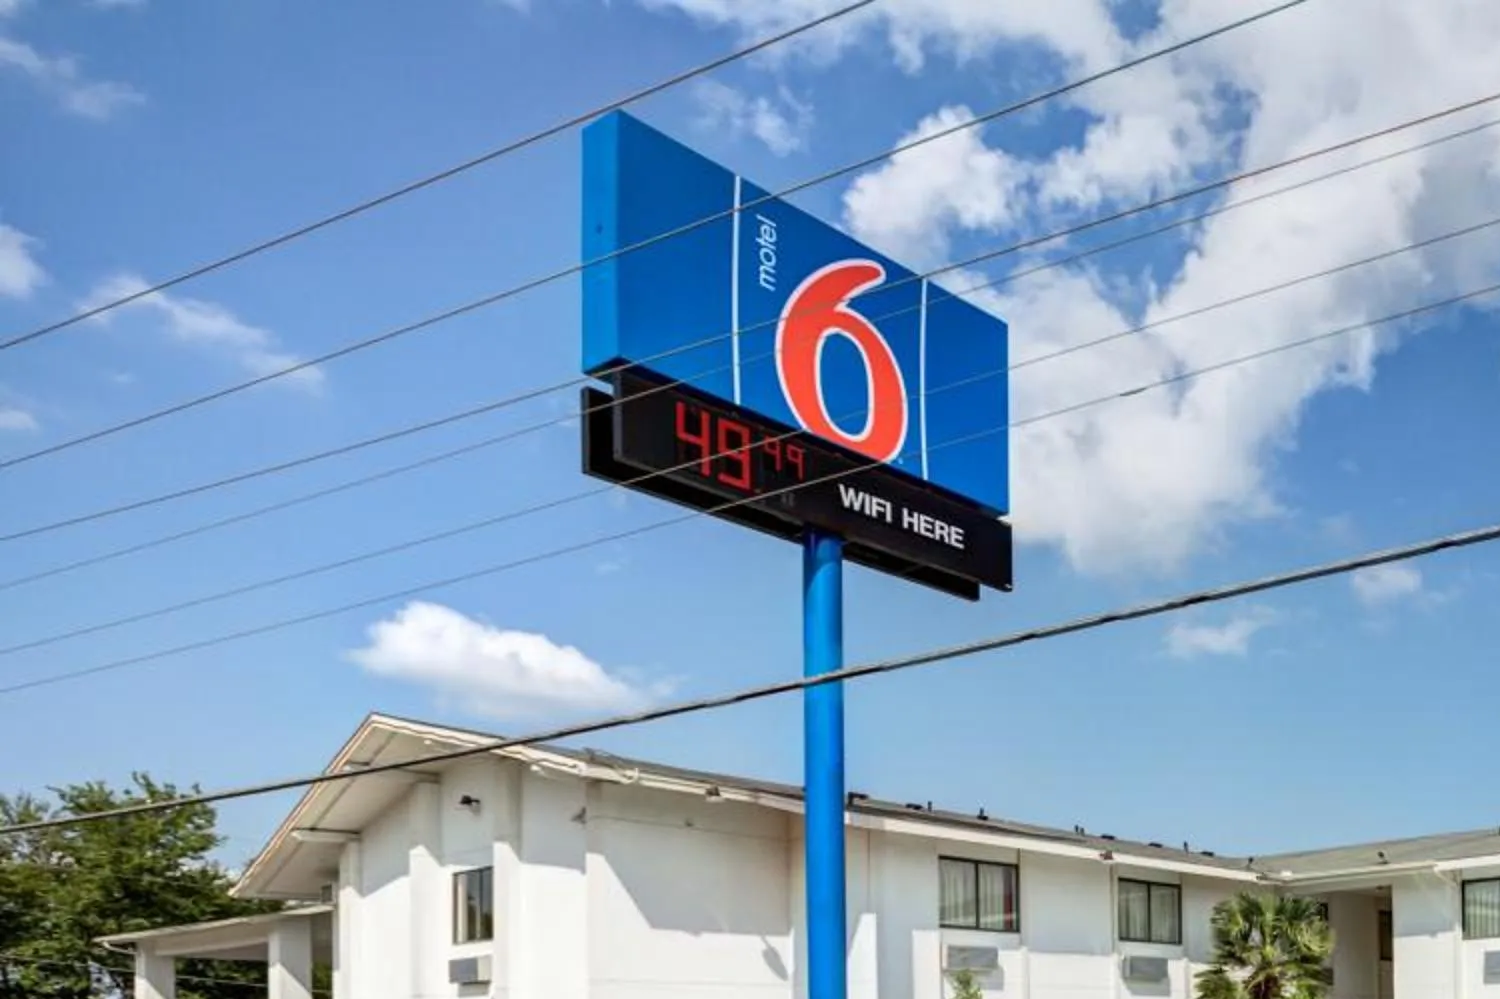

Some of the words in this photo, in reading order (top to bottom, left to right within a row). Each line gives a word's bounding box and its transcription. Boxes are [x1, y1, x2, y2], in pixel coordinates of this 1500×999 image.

[756, 214, 777, 291] motel
[775, 258, 908, 463] 6
[838, 483, 893, 523] WIFI
[902, 507, 965, 549] HERE
